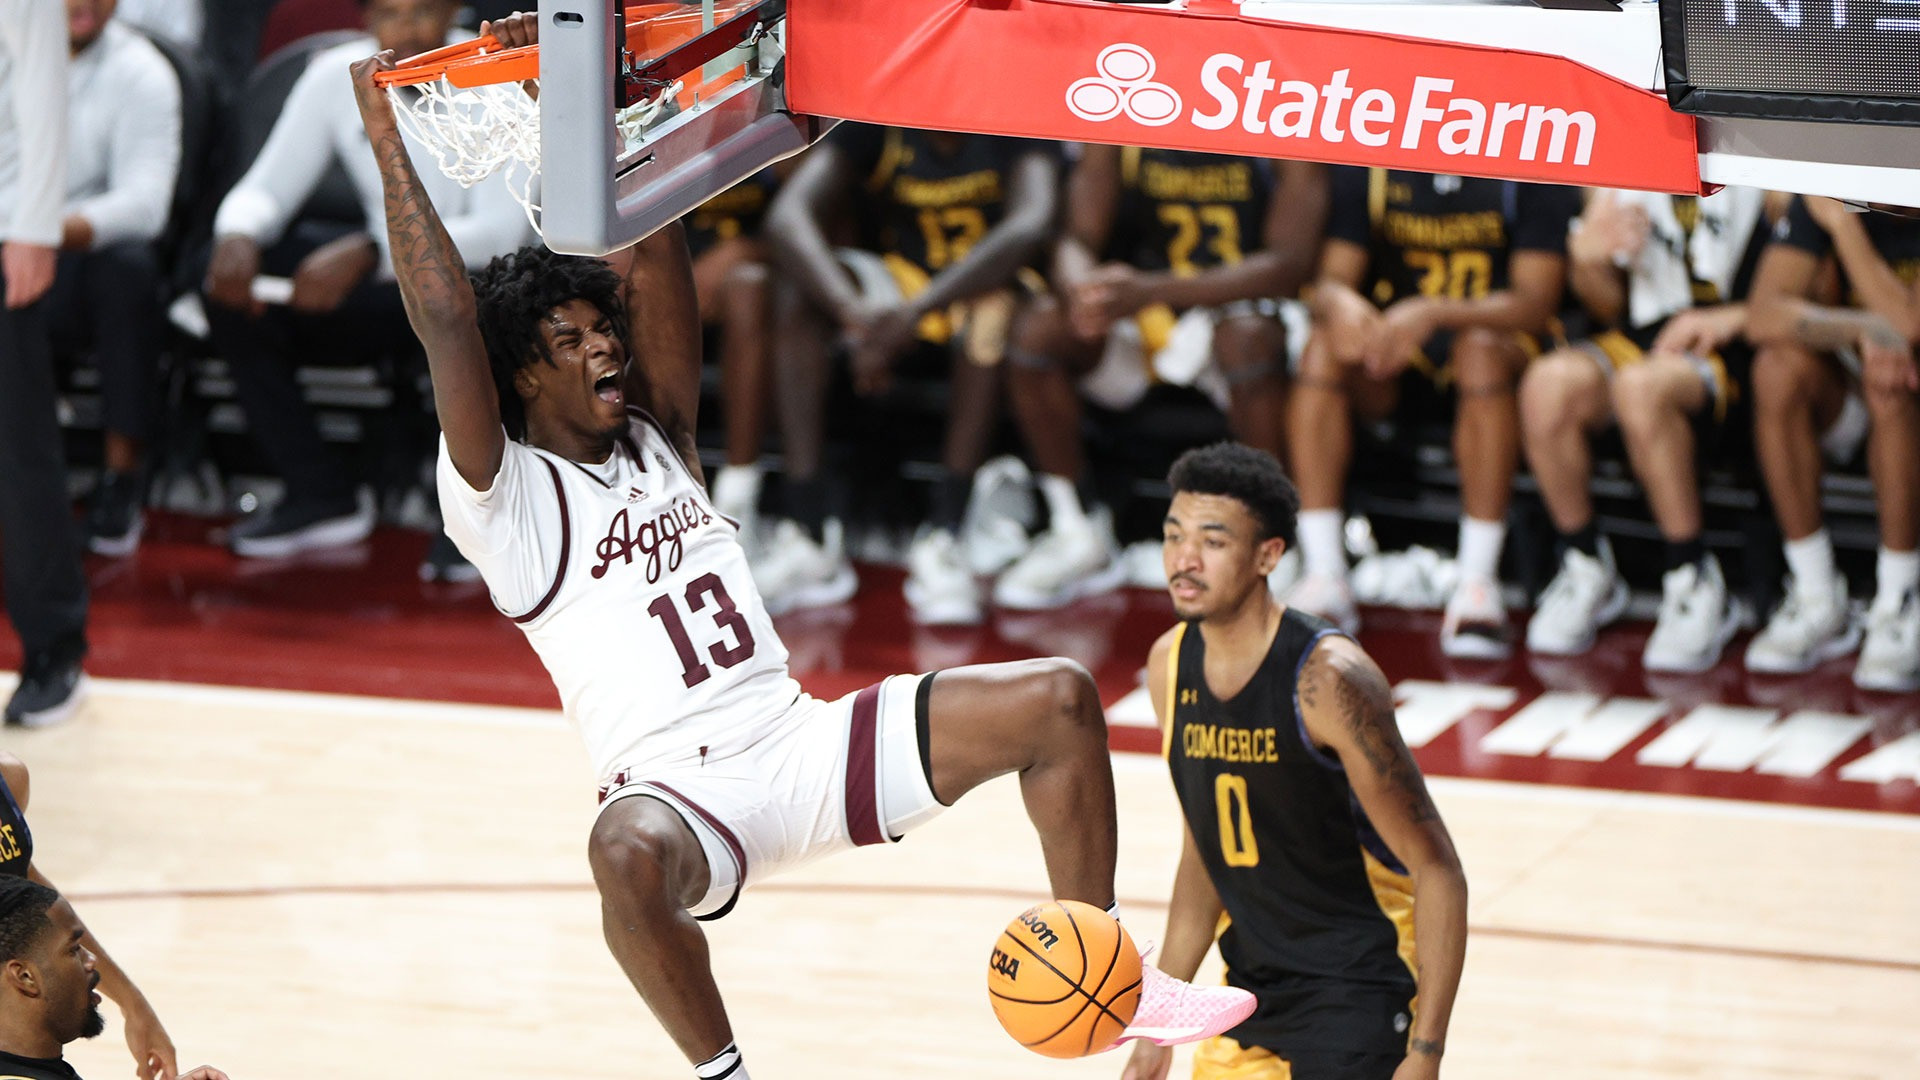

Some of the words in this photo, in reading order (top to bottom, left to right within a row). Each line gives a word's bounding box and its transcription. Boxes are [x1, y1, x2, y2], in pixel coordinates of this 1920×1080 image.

[1155, 203, 1245, 279] 23
[590, 496, 714, 585] Aggies
[646, 571, 756, 689] 13
[0, 823, 22, 863] CE
[1214, 772, 1260, 868] 0
[990, 947, 1020, 981] CAA
